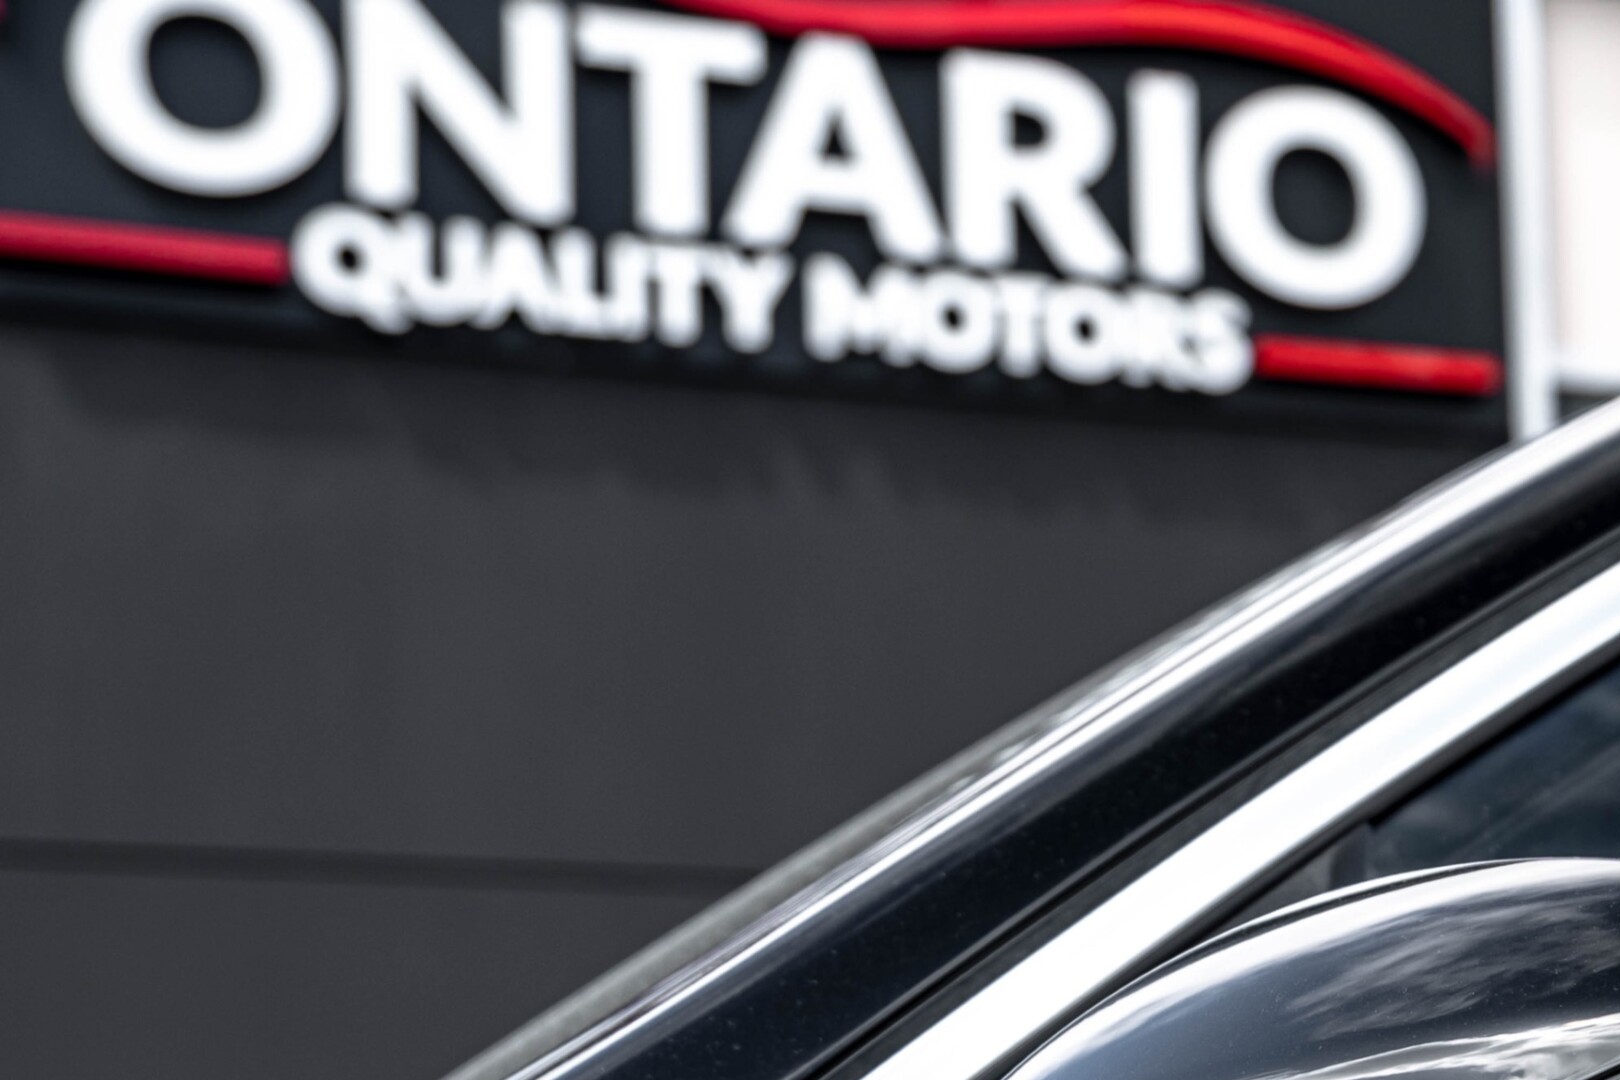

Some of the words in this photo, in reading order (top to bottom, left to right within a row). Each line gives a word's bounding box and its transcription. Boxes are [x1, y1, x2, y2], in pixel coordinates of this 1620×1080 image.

[65, 0, 1427, 310] ONTARIO
[289, 202, 796, 354] QUALITY
[800, 251, 1255, 396] MOTORS
